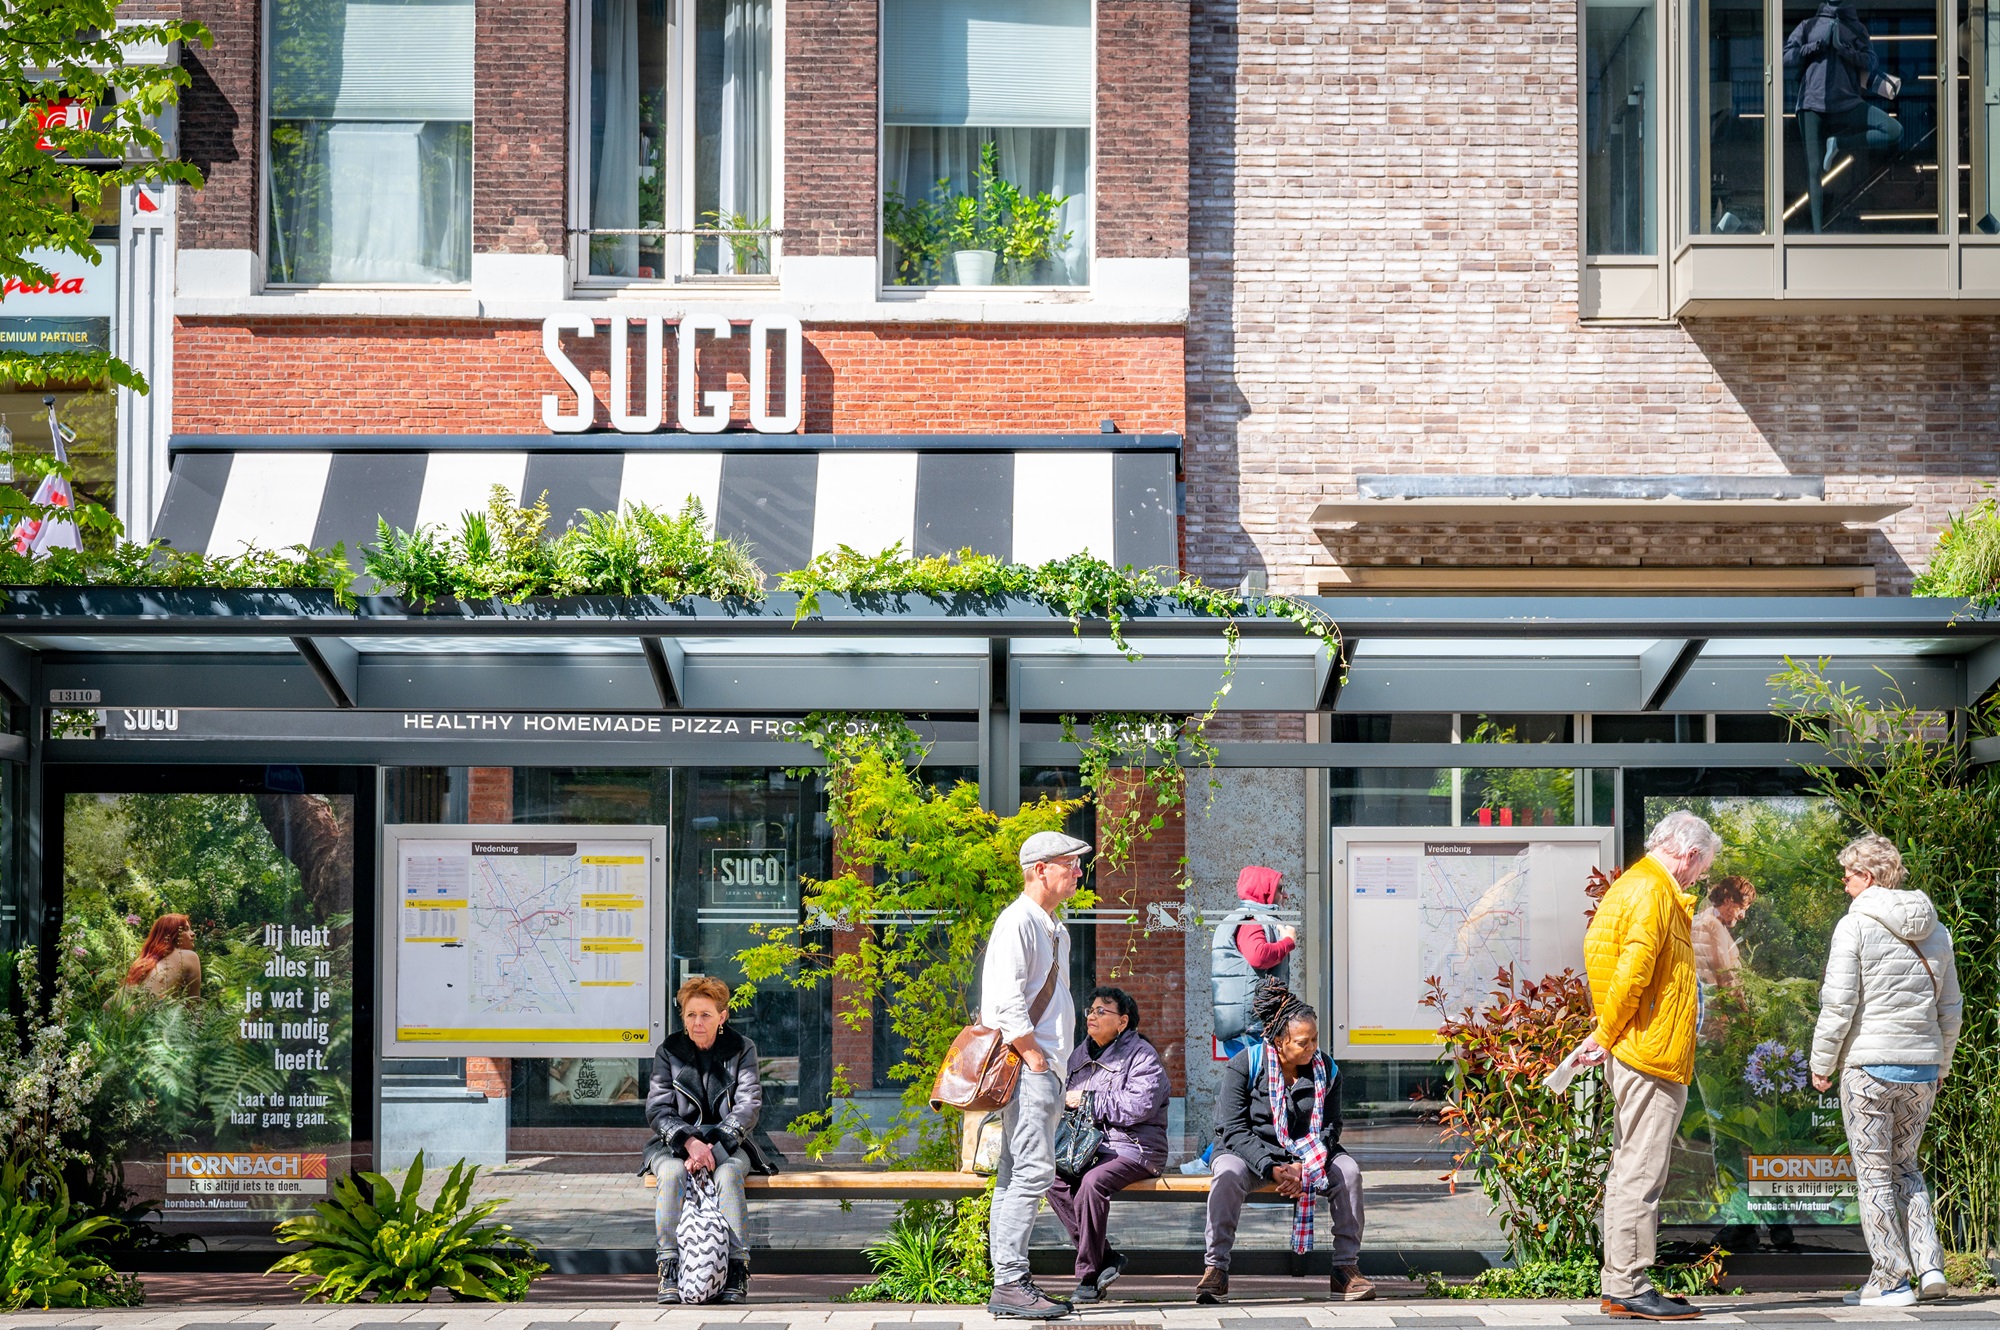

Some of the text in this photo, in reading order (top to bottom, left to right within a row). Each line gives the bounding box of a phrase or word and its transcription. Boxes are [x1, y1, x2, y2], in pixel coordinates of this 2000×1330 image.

[40, 331, 88, 343] PARTNER
[542, 313, 803, 433] SUGO
[58, 691, 93, 701] 13110
[403, 714, 513, 730] HEALTHY
[524, 716, 662, 732] HOMEMADE
[671, 718, 740, 734] PIZZA
[474, 844, 520, 855] Vredenburg
[1427, 845, 1472, 855] Vredenburg
[721, 857, 780, 887] SUGO
[263, 924, 331, 951] Jij hebt
[264, 955, 330, 978] alles in
[244, 986, 330, 1013] je wat je
[240, 1017, 330, 1045] tuin nodig
[274, 1048, 329, 1071] heeft.
[238, 1092, 329, 1107] Laat de natuur
[231, 1109, 329, 1128] haar gang gaan.
[169, 1155, 299, 1176] HORNBACH
[190, 1180, 302, 1194] Er is altijd iets te doen.
[1772, 1182, 1782, 1194] Er
[1785, 1182, 1794, 1194] is
[1797, 1182, 1822, 1196] altijd
[1825, 1182, 1843, 1194] iets
[164, 1199, 249, 1209] hornbach.nl/natuur
[1747, 1201, 1831, 1211] hornbach.nl/natuur
